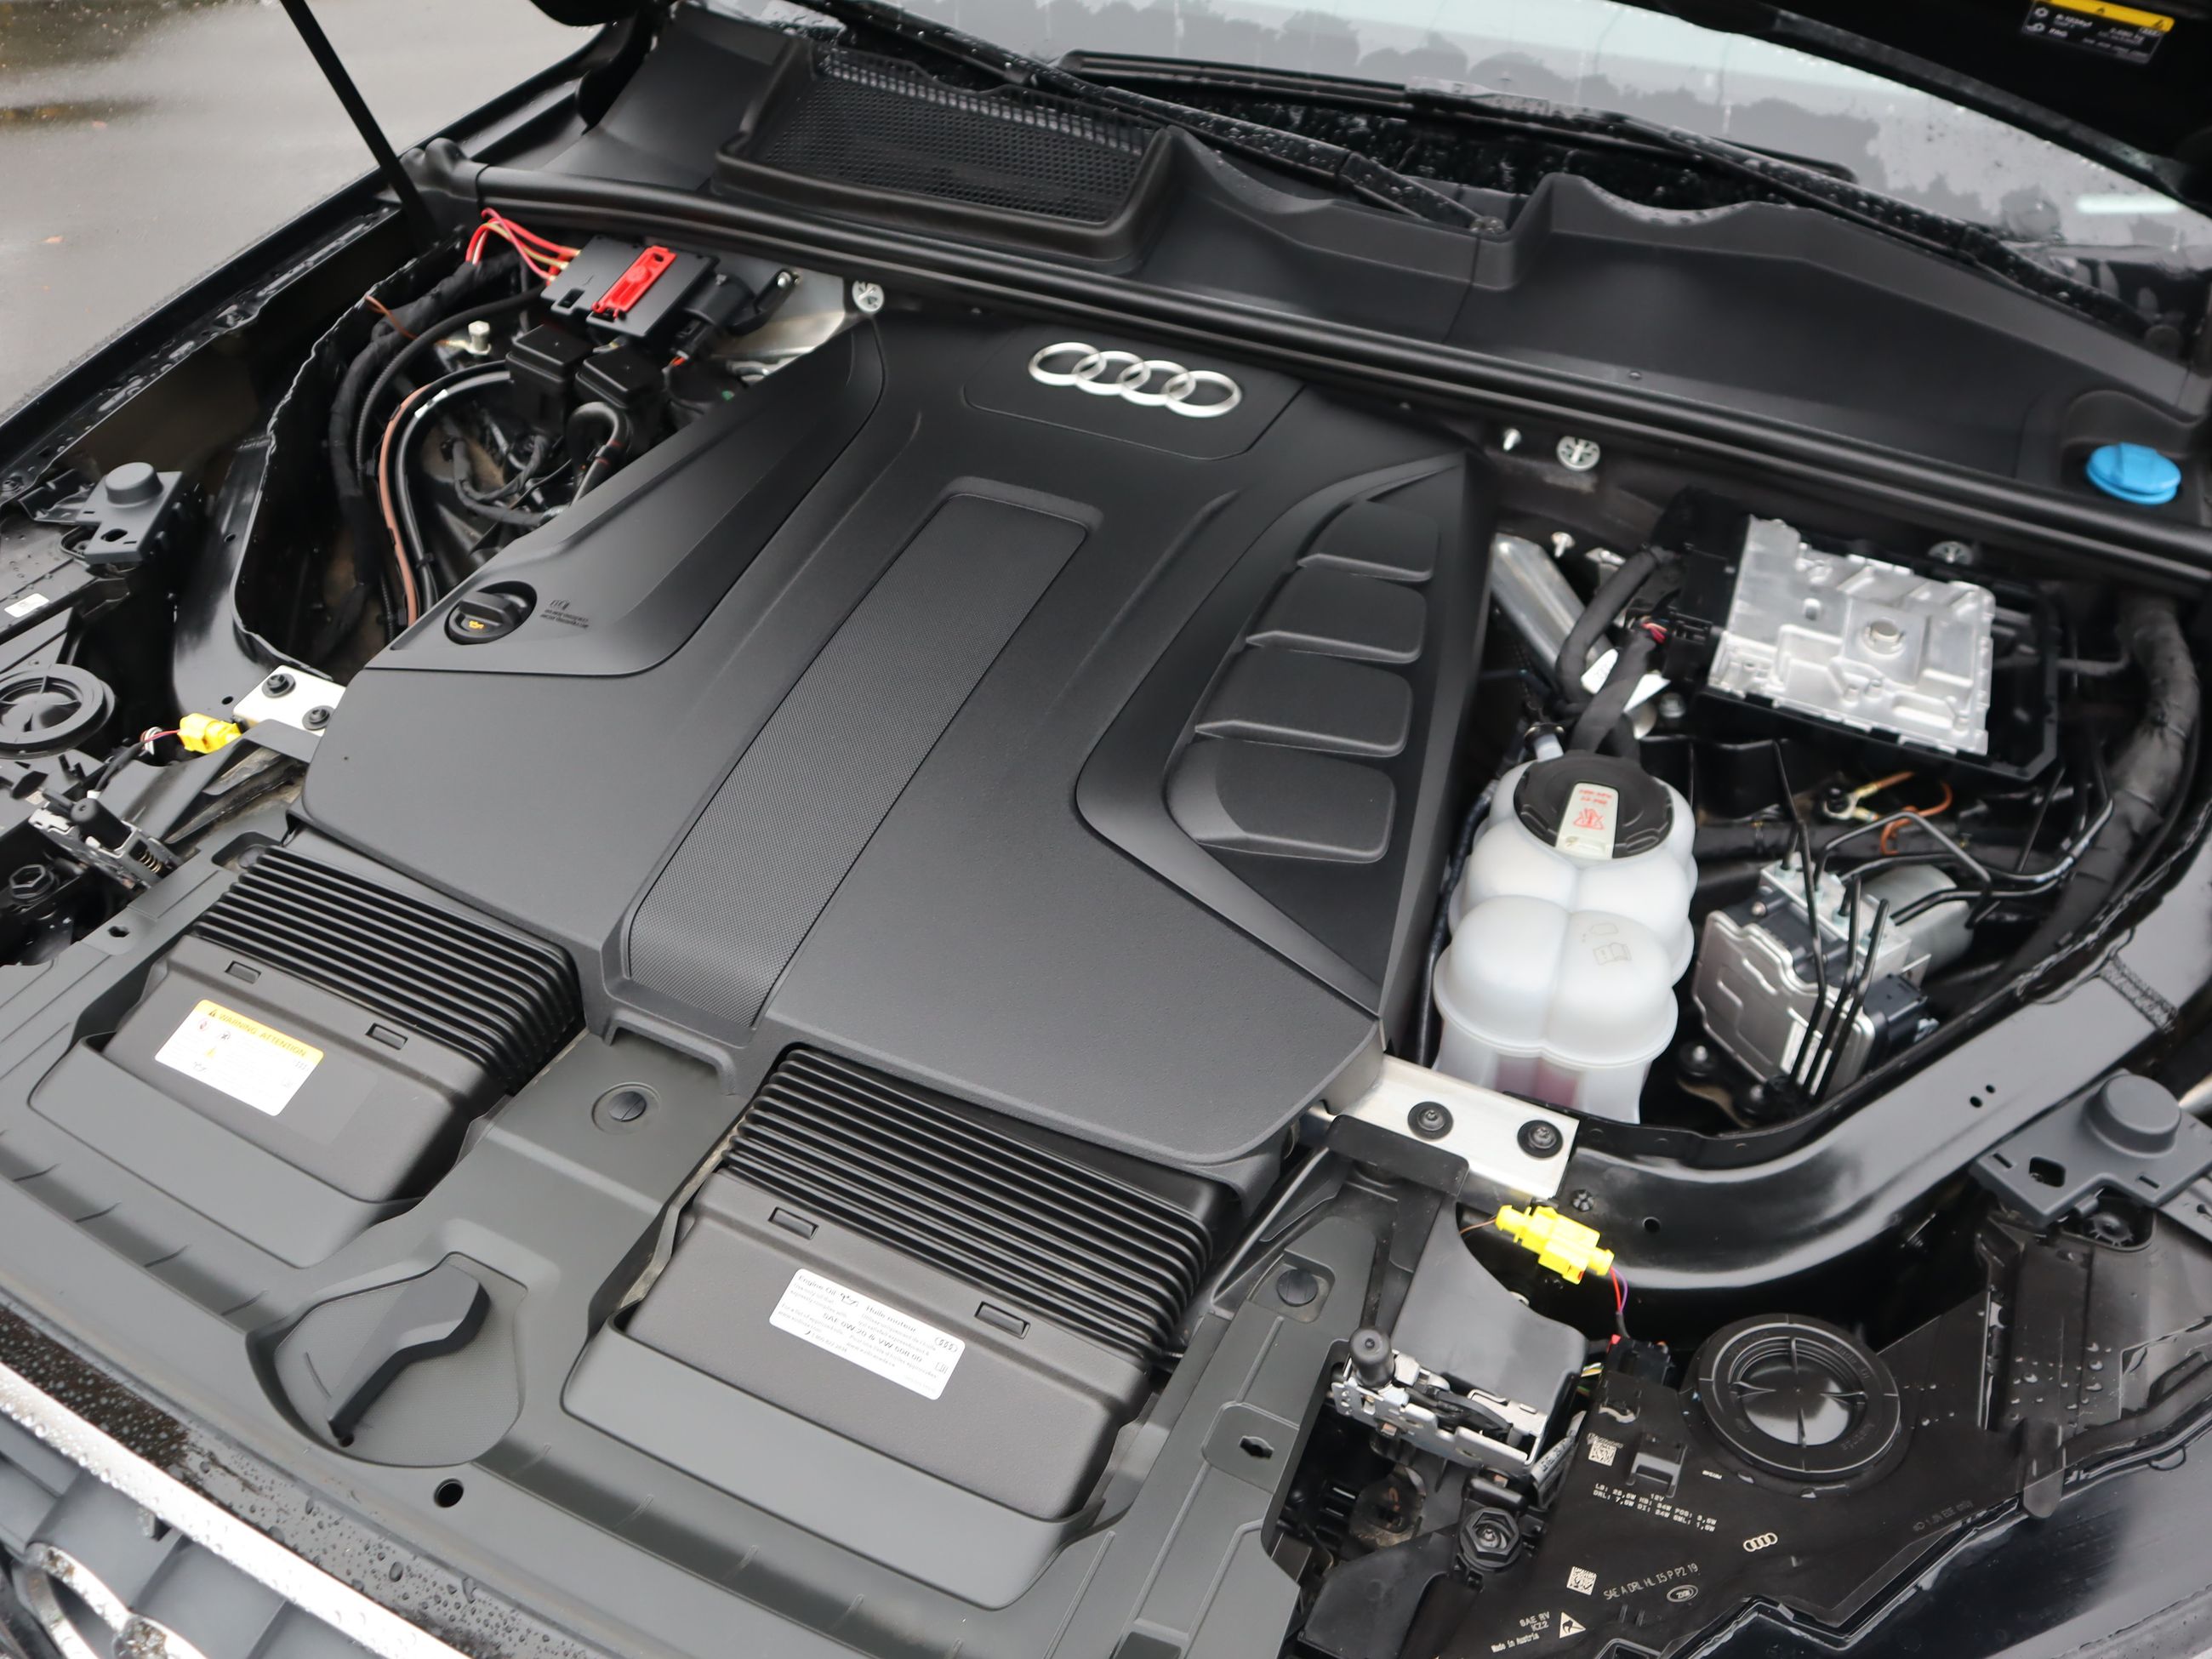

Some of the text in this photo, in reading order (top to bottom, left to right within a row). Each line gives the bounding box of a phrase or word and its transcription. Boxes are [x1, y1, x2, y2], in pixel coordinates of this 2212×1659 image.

[219, 1014, 307, 1056] WARNING ATTENTION
[797, 1275, 836, 1295] Engine Oil
[866, 1305, 915, 1332] Huile moteur
[822, 1313, 840, 1324] SAE
[877, 1338, 893, 1348] VW
[1593, 1490, 1611, 1500] DRL:
[1603, 1588, 1621, 1600] SAE
[1621, 1585, 1628, 1595] A
[1627, 1581, 1645, 1593] DRL
[1643, 1577, 1656, 1588] HL
[1666, 1570, 1674, 1580] P
[1674, 1566, 1687, 1577] P2
[1687, 1562, 1699, 1573] 19
[1519, 1611, 1550, 1627] SAE RV
[1531, 1620, 1549, 1632] KZ2
[1491, 1632, 1540, 1653] Made in Austria
